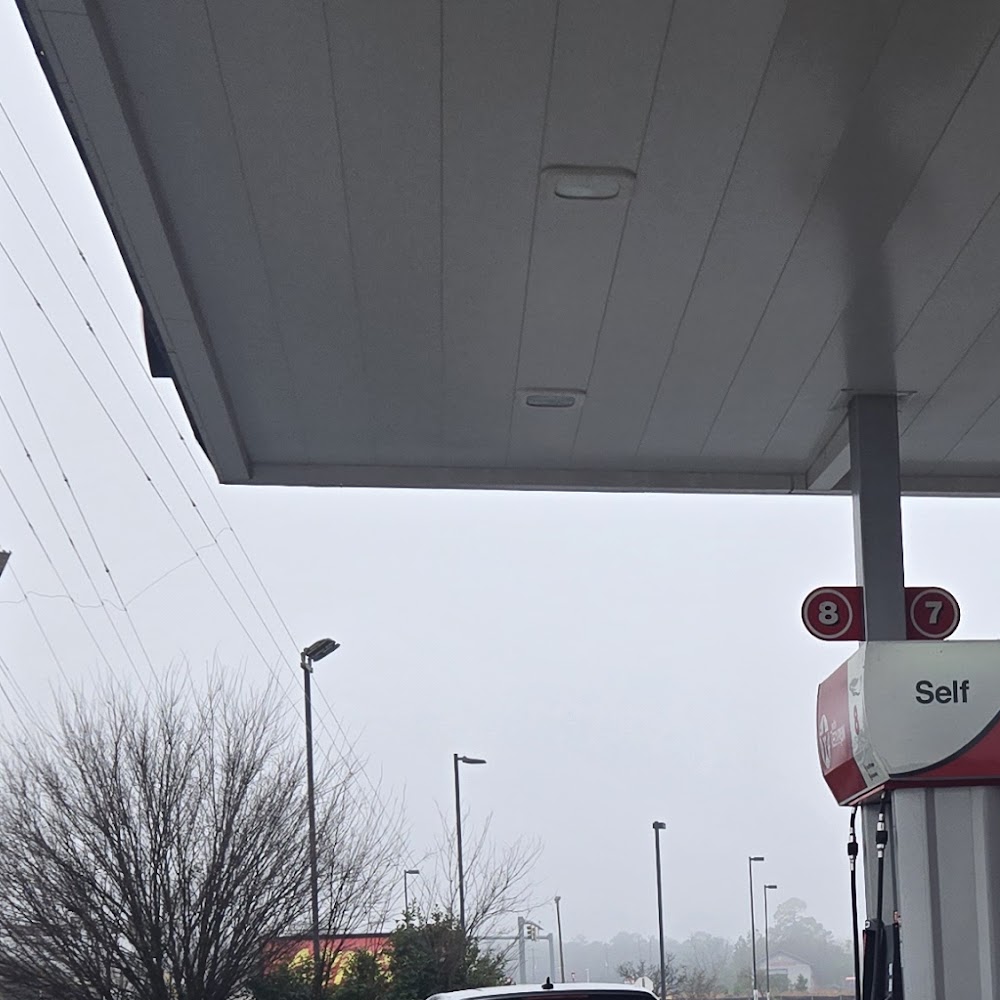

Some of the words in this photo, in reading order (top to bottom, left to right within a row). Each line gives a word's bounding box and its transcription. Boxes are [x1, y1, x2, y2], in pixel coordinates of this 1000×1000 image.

[818, 600, 839, 625] 8
[925, 601, 943, 624] 7
[915, 680, 970, 704] Self
